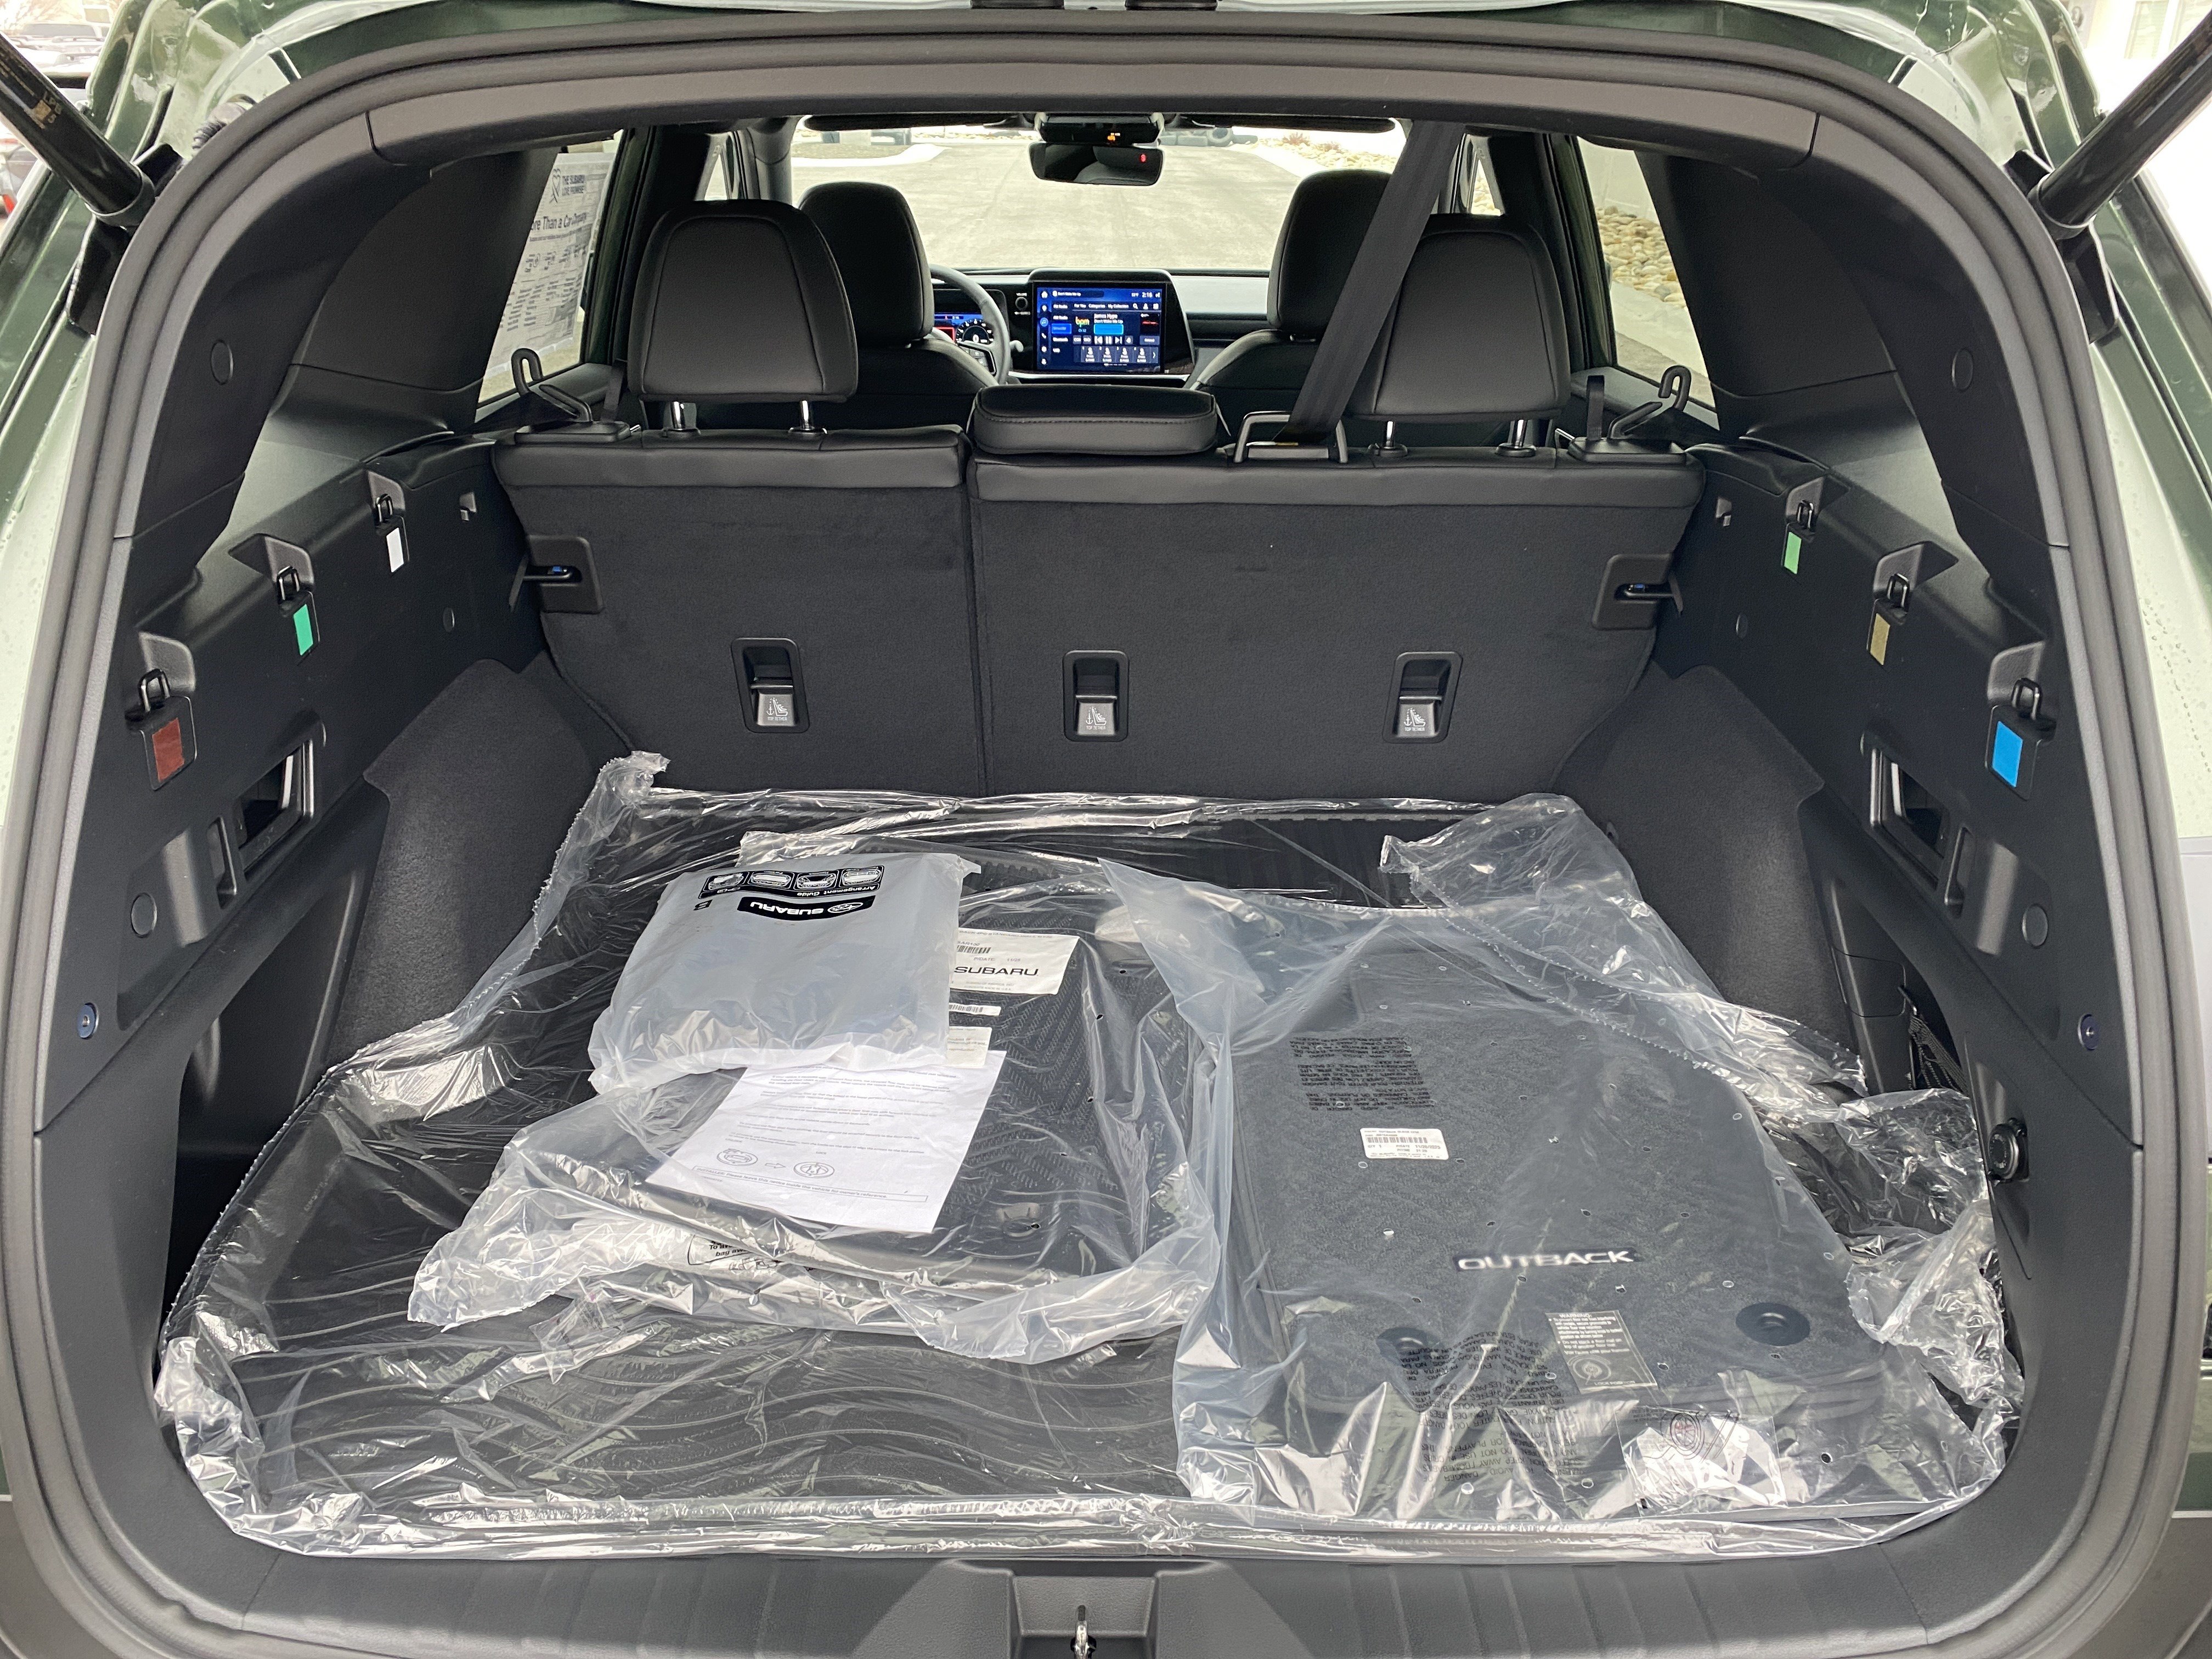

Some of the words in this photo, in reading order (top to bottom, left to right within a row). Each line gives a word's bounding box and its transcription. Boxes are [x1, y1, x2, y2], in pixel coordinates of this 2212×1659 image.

[543, 216, 557, 230] Than
[823, 885, 876, 895] Arrangement
[749, 901, 824, 915] SUBARU
[953, 966, 1039, 977] SUBARU
[1458, 1250, 1634, 1270] OUTBACK
[1477, 1400, 1493, 1408] PAS
[1490, 1437, 1503, 1446] OR
[1461, 1451, 1477, 1460] USE
[1481, 1448, 1497, 1457] NOT
[1479, 1457, 1502, 1466] AWAY
[1444, 1471, 1478, 1481] DANGER
